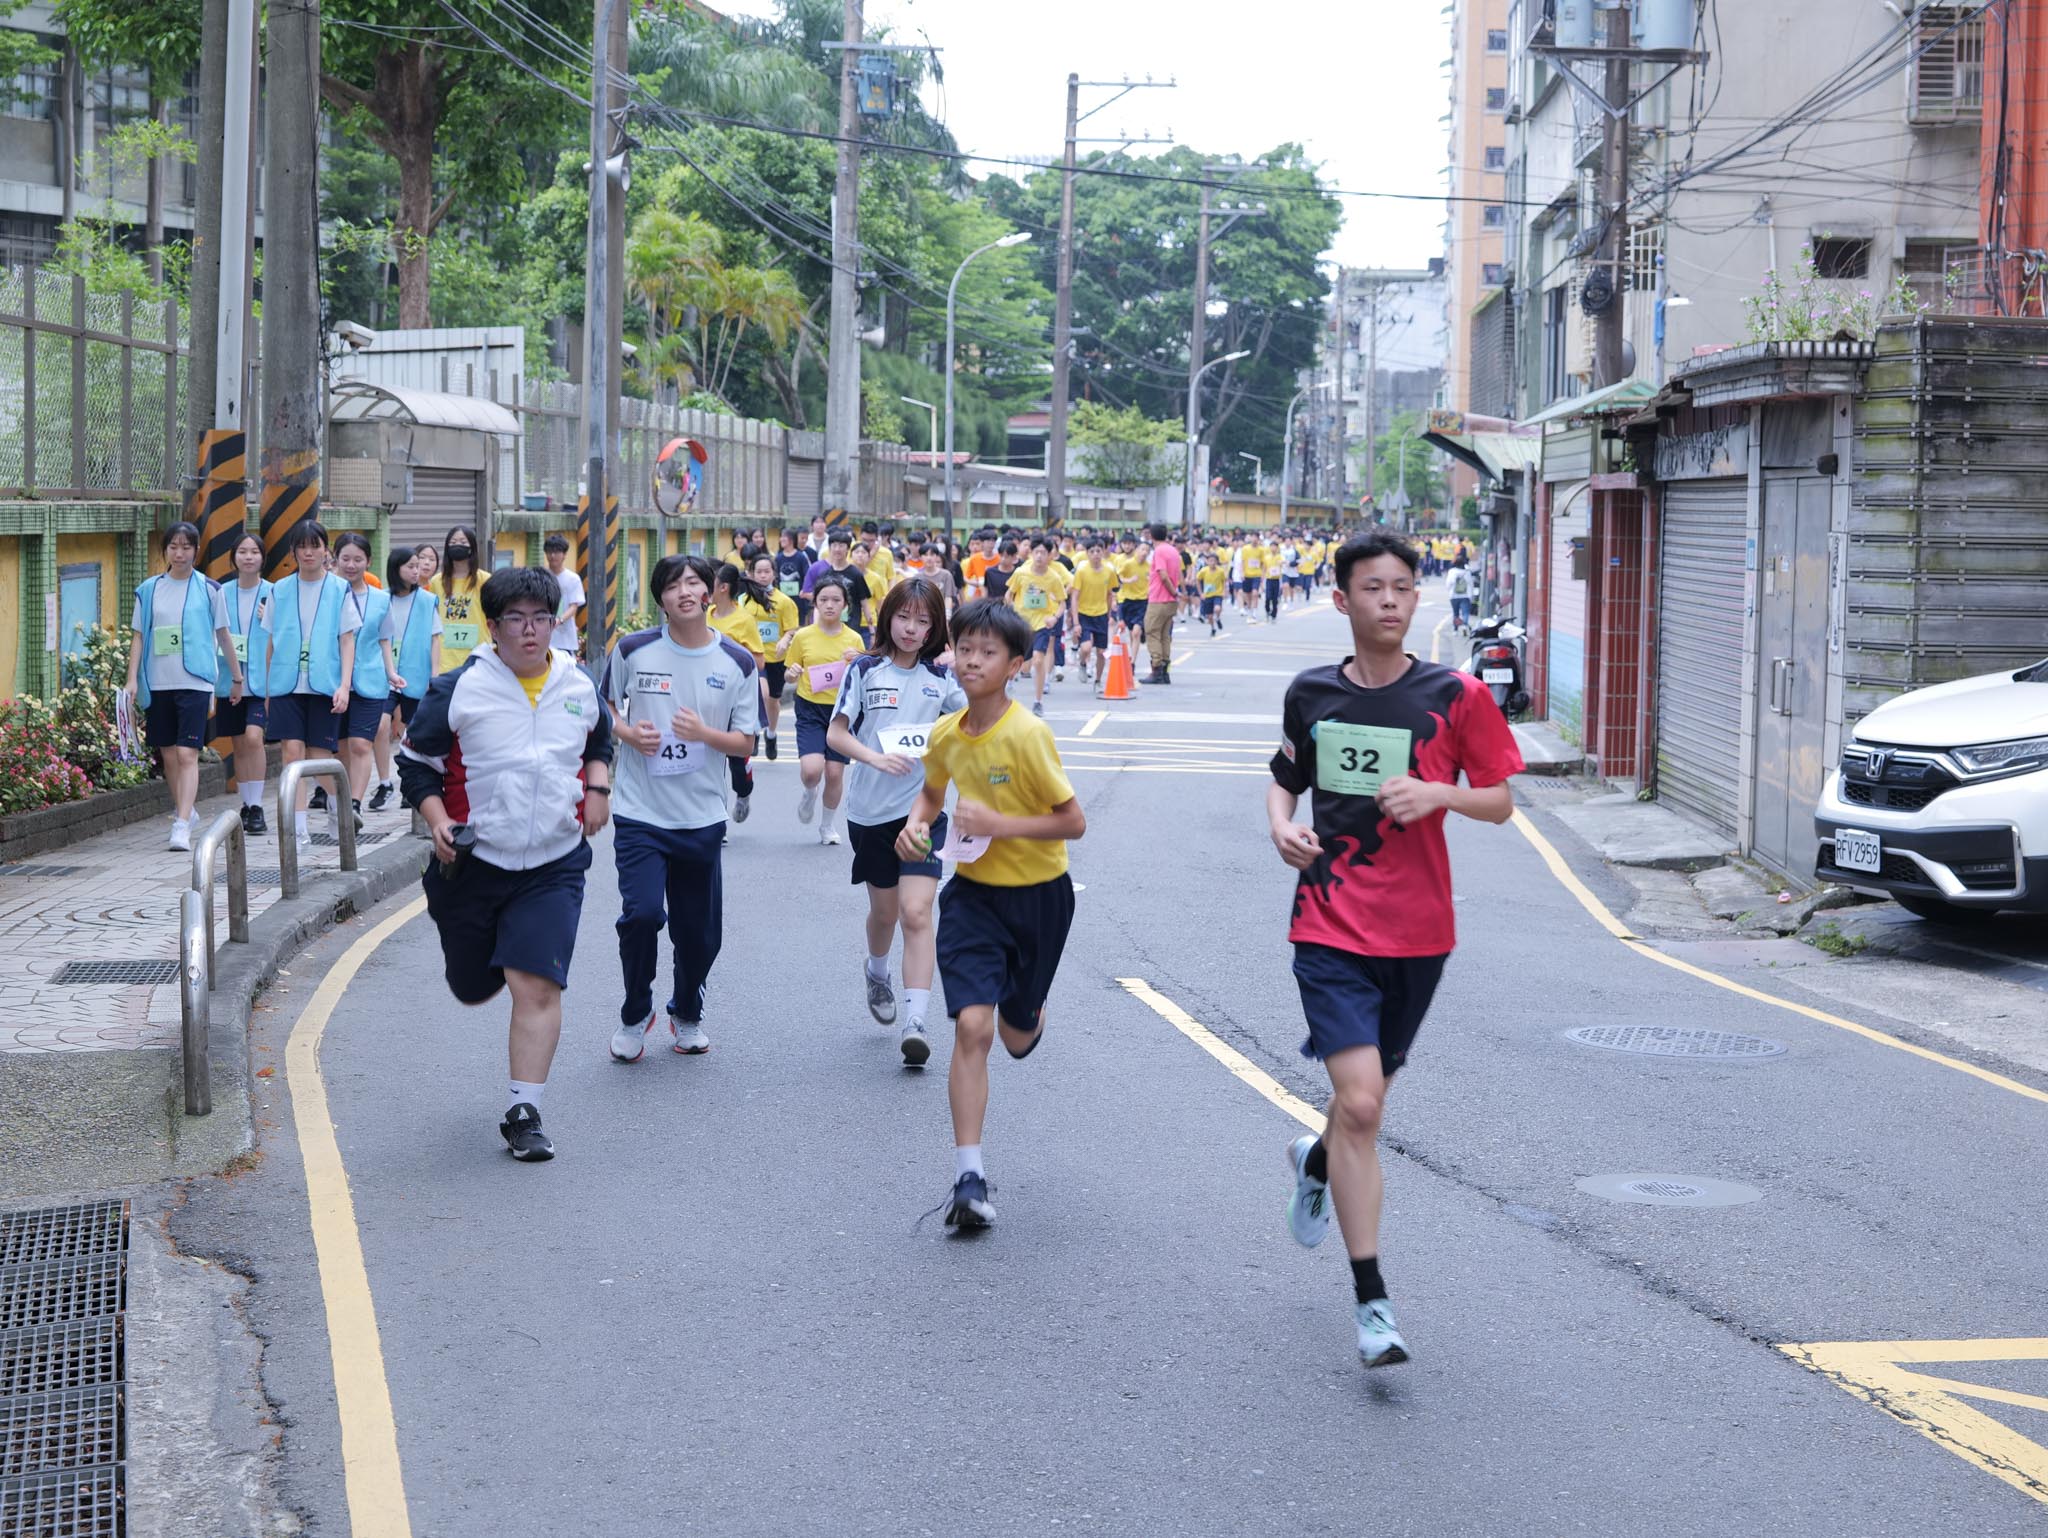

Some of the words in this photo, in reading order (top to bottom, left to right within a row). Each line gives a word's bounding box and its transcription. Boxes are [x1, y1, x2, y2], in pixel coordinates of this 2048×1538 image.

[170, 634, 179, 645] 3
[454, 632, 468, 641] 17
[236, 643, 244, 652] 4
[300, 651, 309, 661] 2
[824, 672, 833, 682] 9
[898, 735, 925, 748] 40
[661, 743, 688, 760] 43
[1339, 747, 1380, 774] 32
